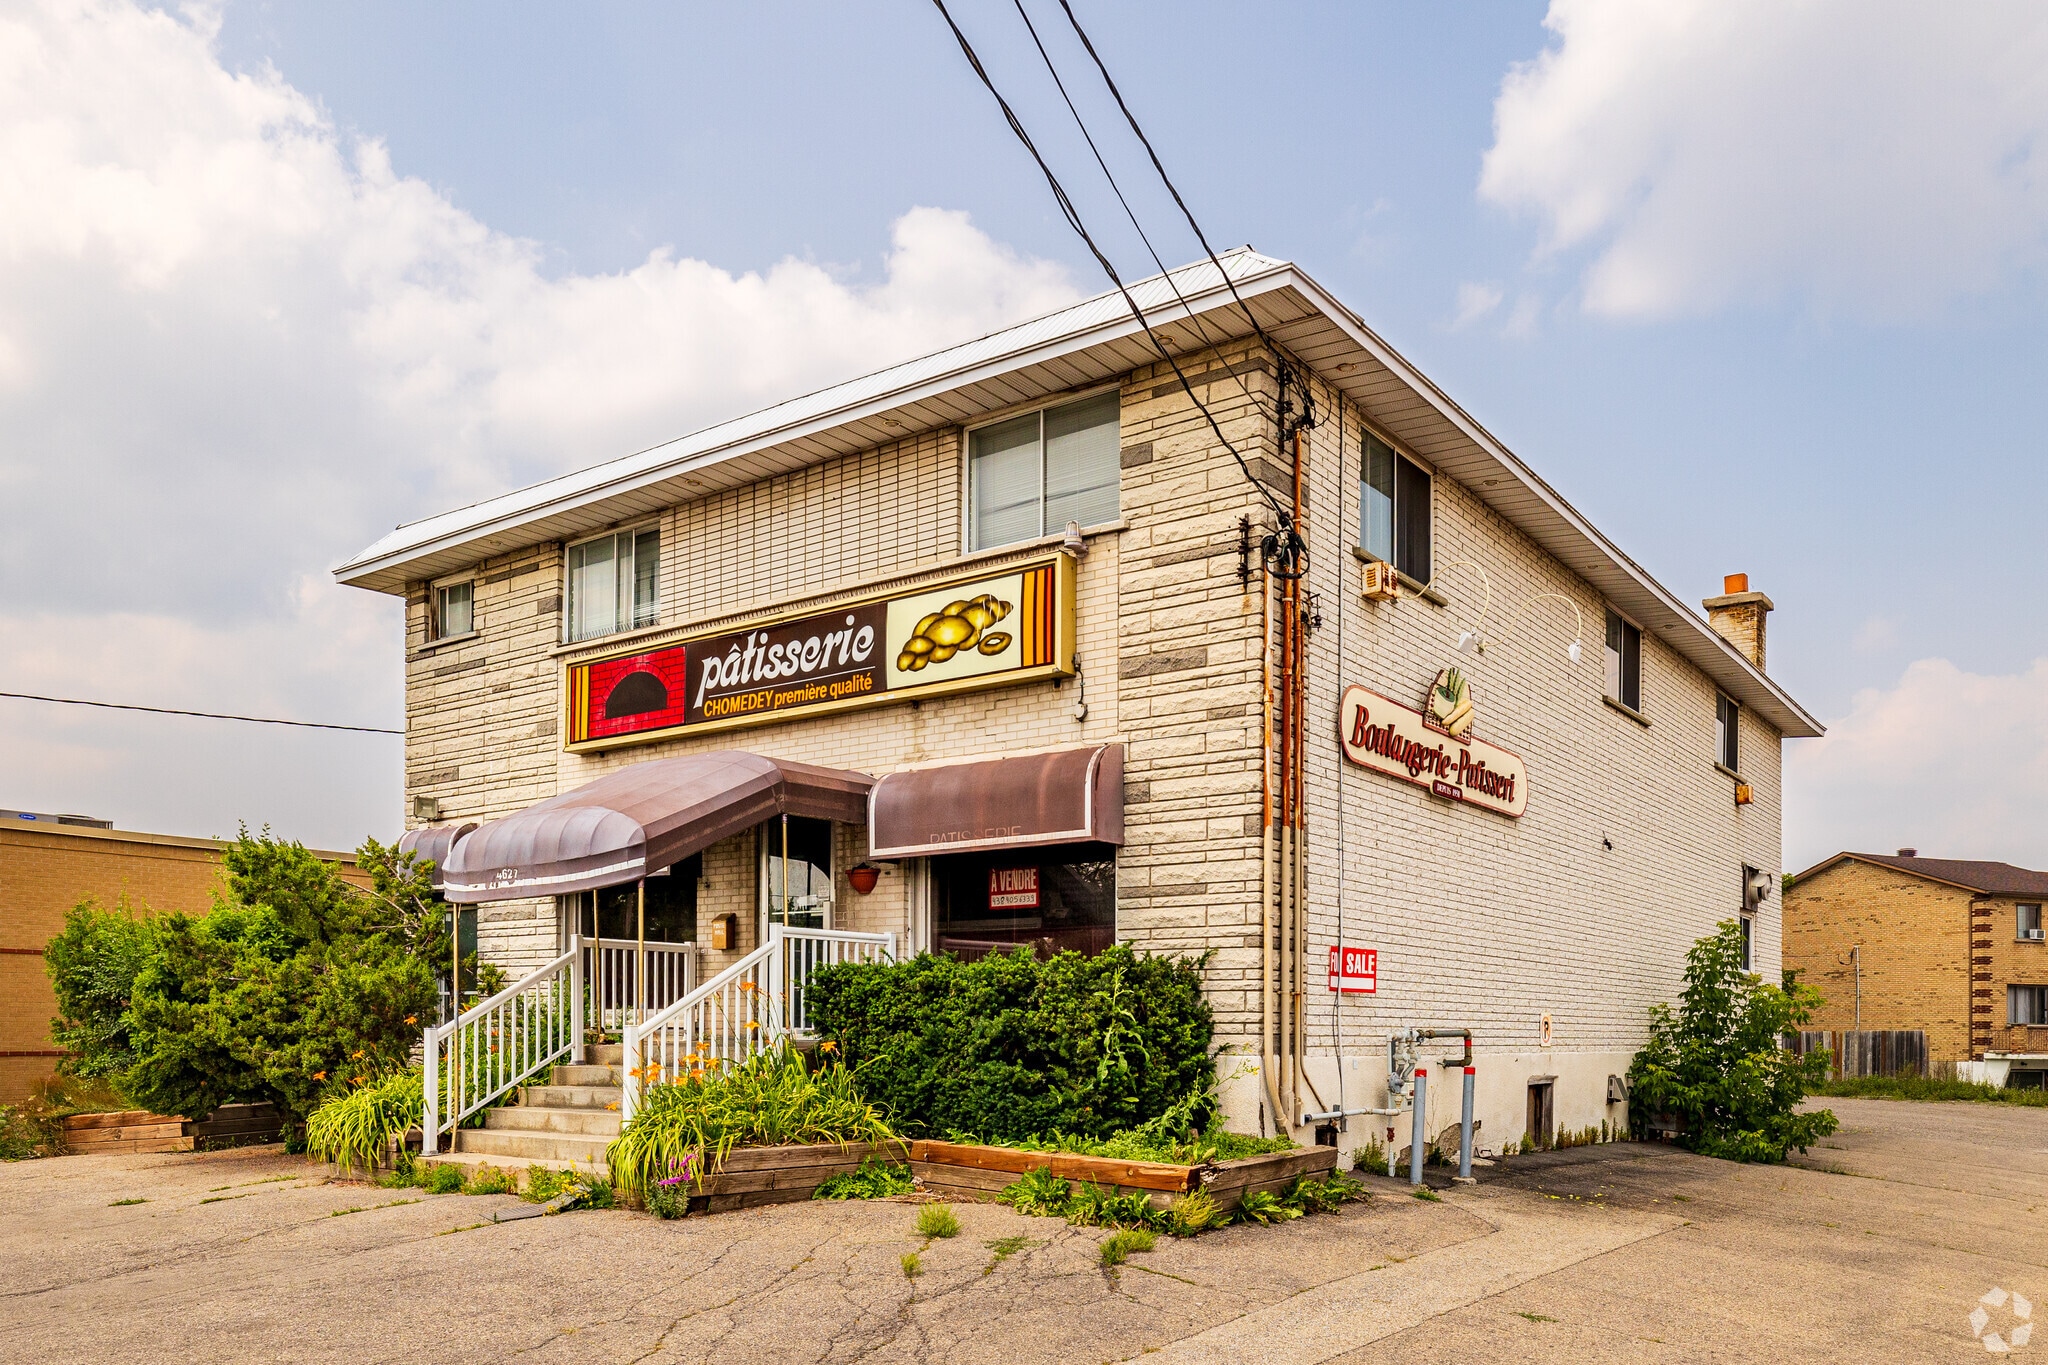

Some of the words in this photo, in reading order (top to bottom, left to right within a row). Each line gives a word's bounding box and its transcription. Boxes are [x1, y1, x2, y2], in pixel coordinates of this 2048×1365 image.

[693, 614, 875, 709] pâtisserie
[704, 690, 774, 717] CHOMEDEY
[774, 682, 827, 709] première
[829, 673, 872, 700] qualité
[991, 868, 998, 892] À
[1000, 868, 1037, 891] VENDRE
[1330, 951, 1340, 972] FO
[1346, 953, 1375, 975] SALE
